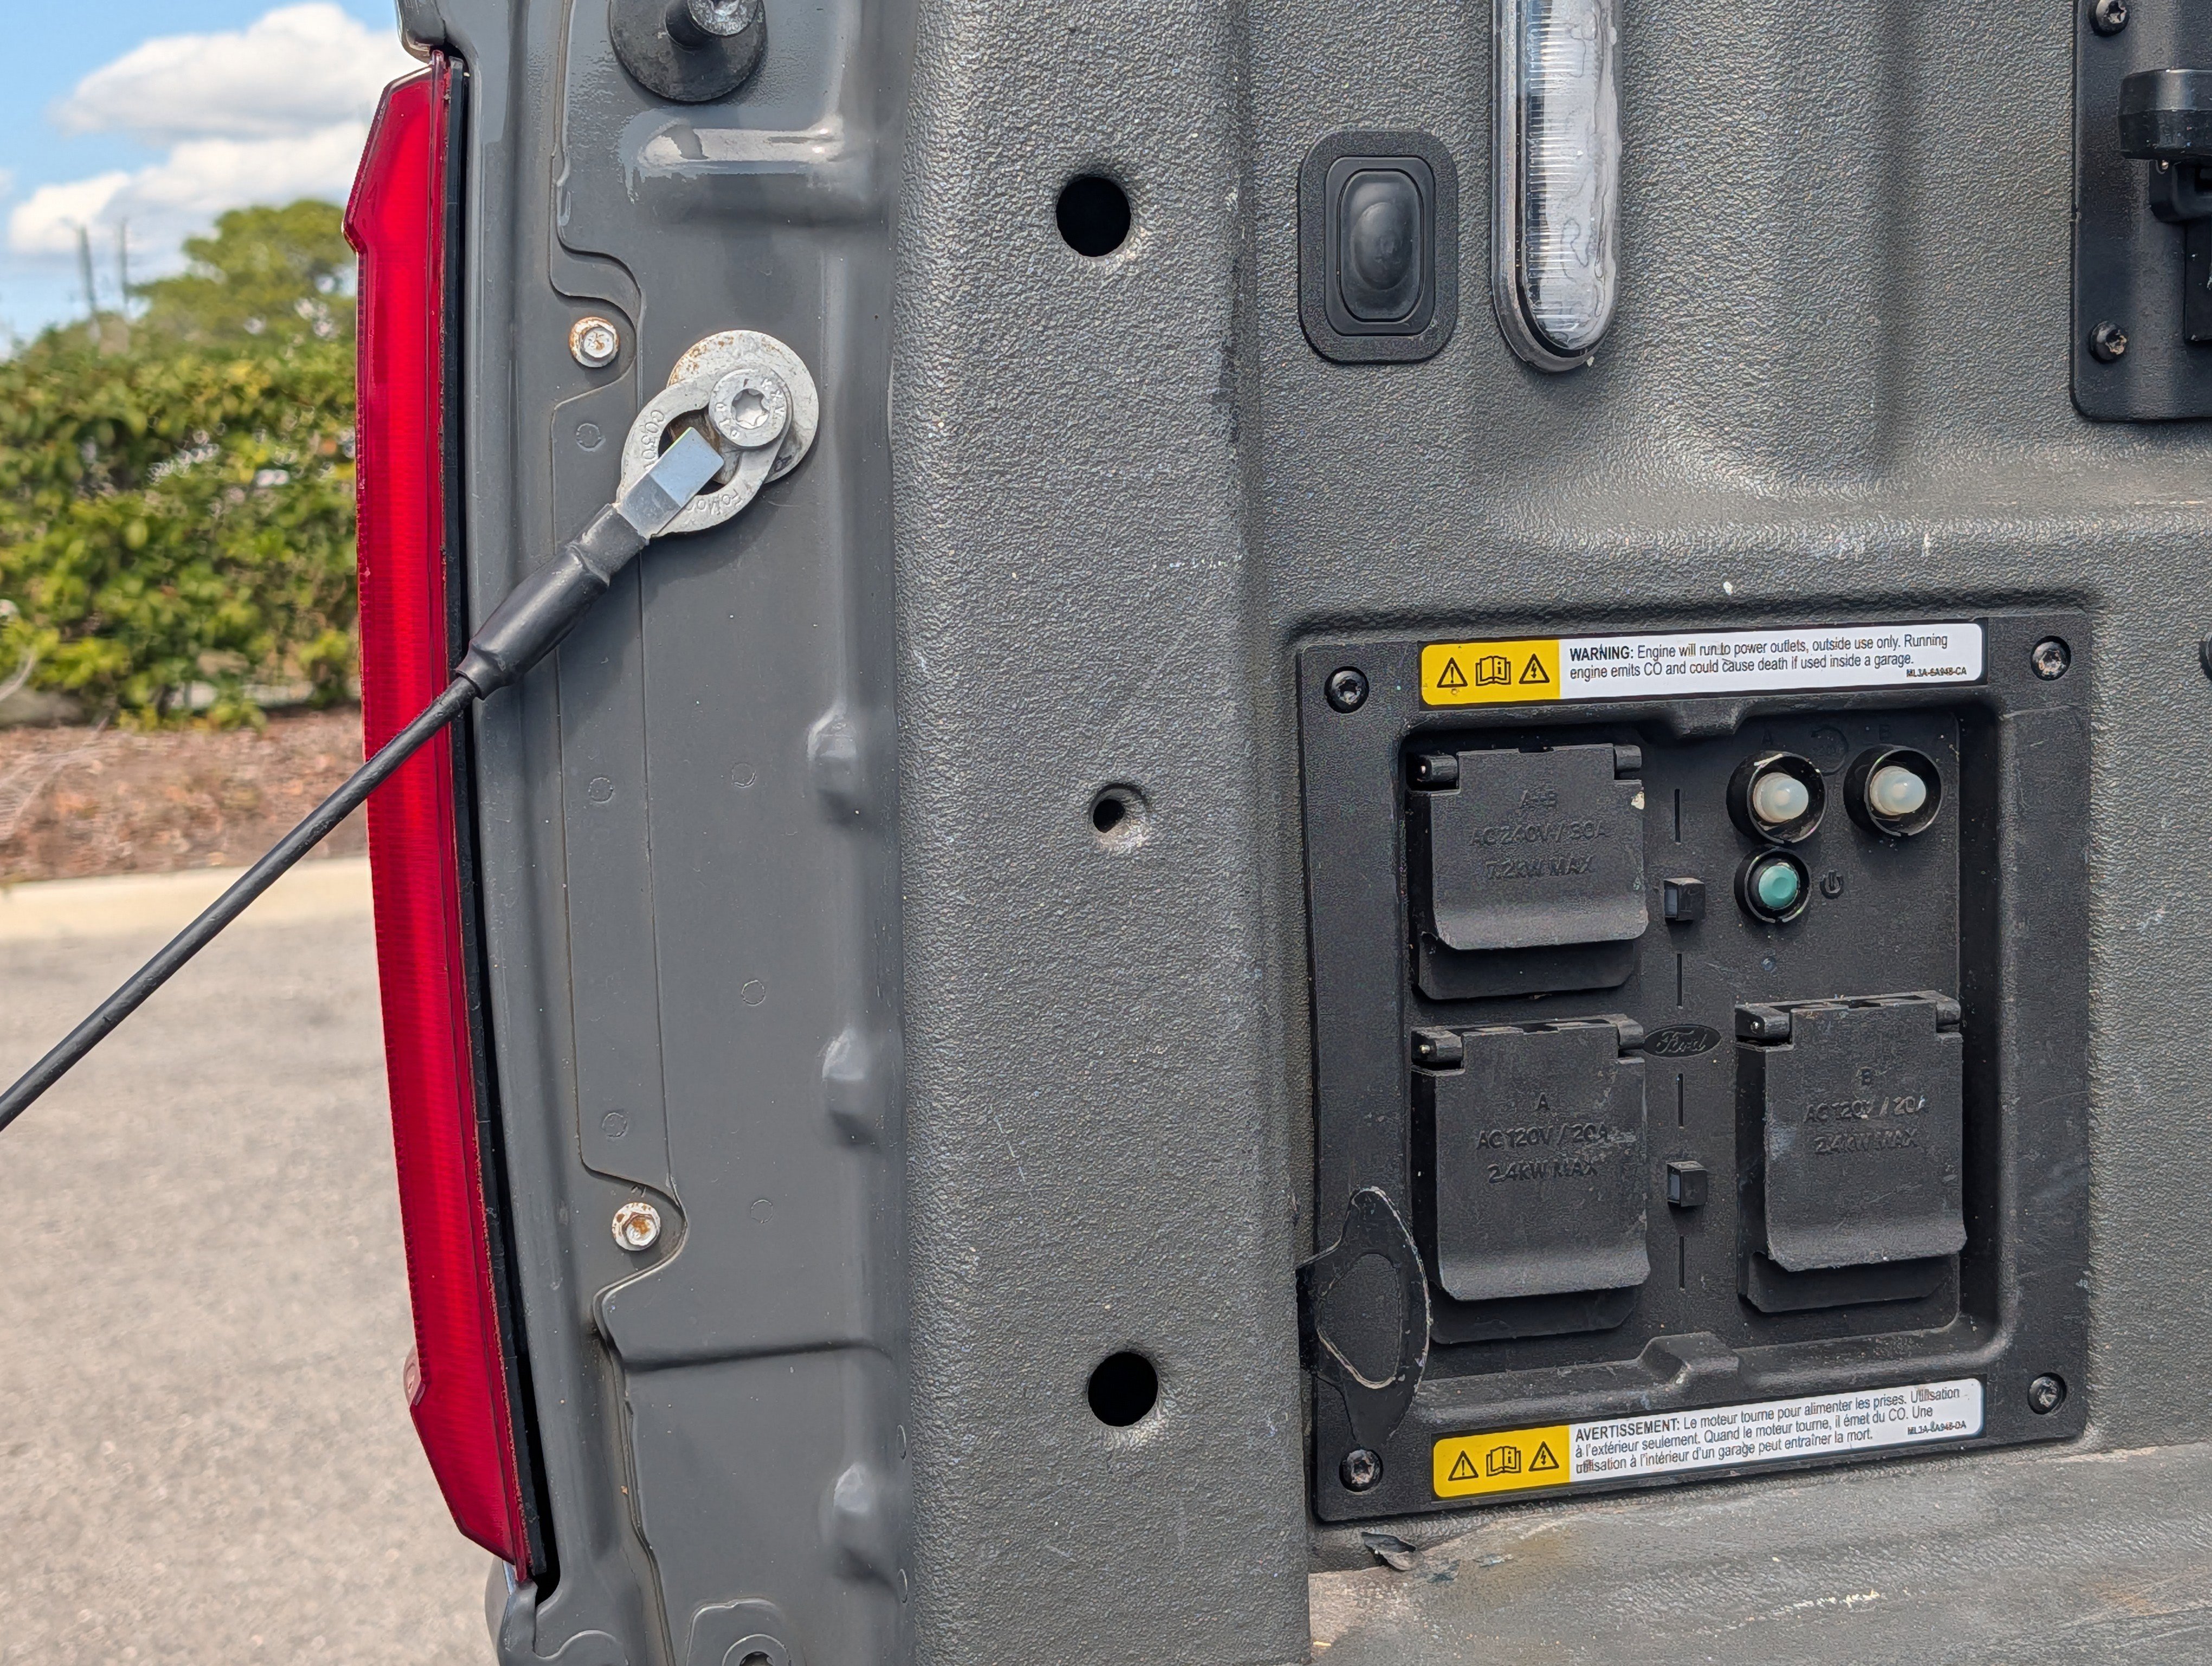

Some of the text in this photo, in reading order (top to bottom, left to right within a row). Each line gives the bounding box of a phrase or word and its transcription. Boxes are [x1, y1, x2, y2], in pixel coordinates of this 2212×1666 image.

[1570, 633, 1948, 661] WARNING: Engine will run to power outlets, outside use only. Running
[1570, 653, 1914, 682] engine emits CO and could cause death if used inside a garage.
[1656, 1030, 1708, 1054] Ford
[1860, 1067, 1873, 1086] B
[1536, 1092, 1551, 1112] A
[1552, 1157, 1598, 1179] MAX
[1575, 1387, 1960, 1443] AVERTISSEMENT: Le moteur tourne pour alimenter les prises. Utilisation
[1575, 1444, 1583, 1458] à
[1585, 1439, 1639, 1457] l'extérieur
[1642, 1432, 1700, 1449] seulement.
[1705, 1426, 1739, 1443] Quand
[1742, 1426, 1752, 1438] le
[1756, 1420, 1792, 1437] moteur
[1835, 1415, 1841, 1428] il
[1843, 1411, 1869, 1427] émet
[1872, 1409, 1886, 1423] du
[1888, 1407, 1908, 1422] CO.
[1912, 1405, 1933, 1419] Une
[1576, 1427, 1873, 1474] utilisation à l'intérieur d'un garage peut entraîner la mort.
